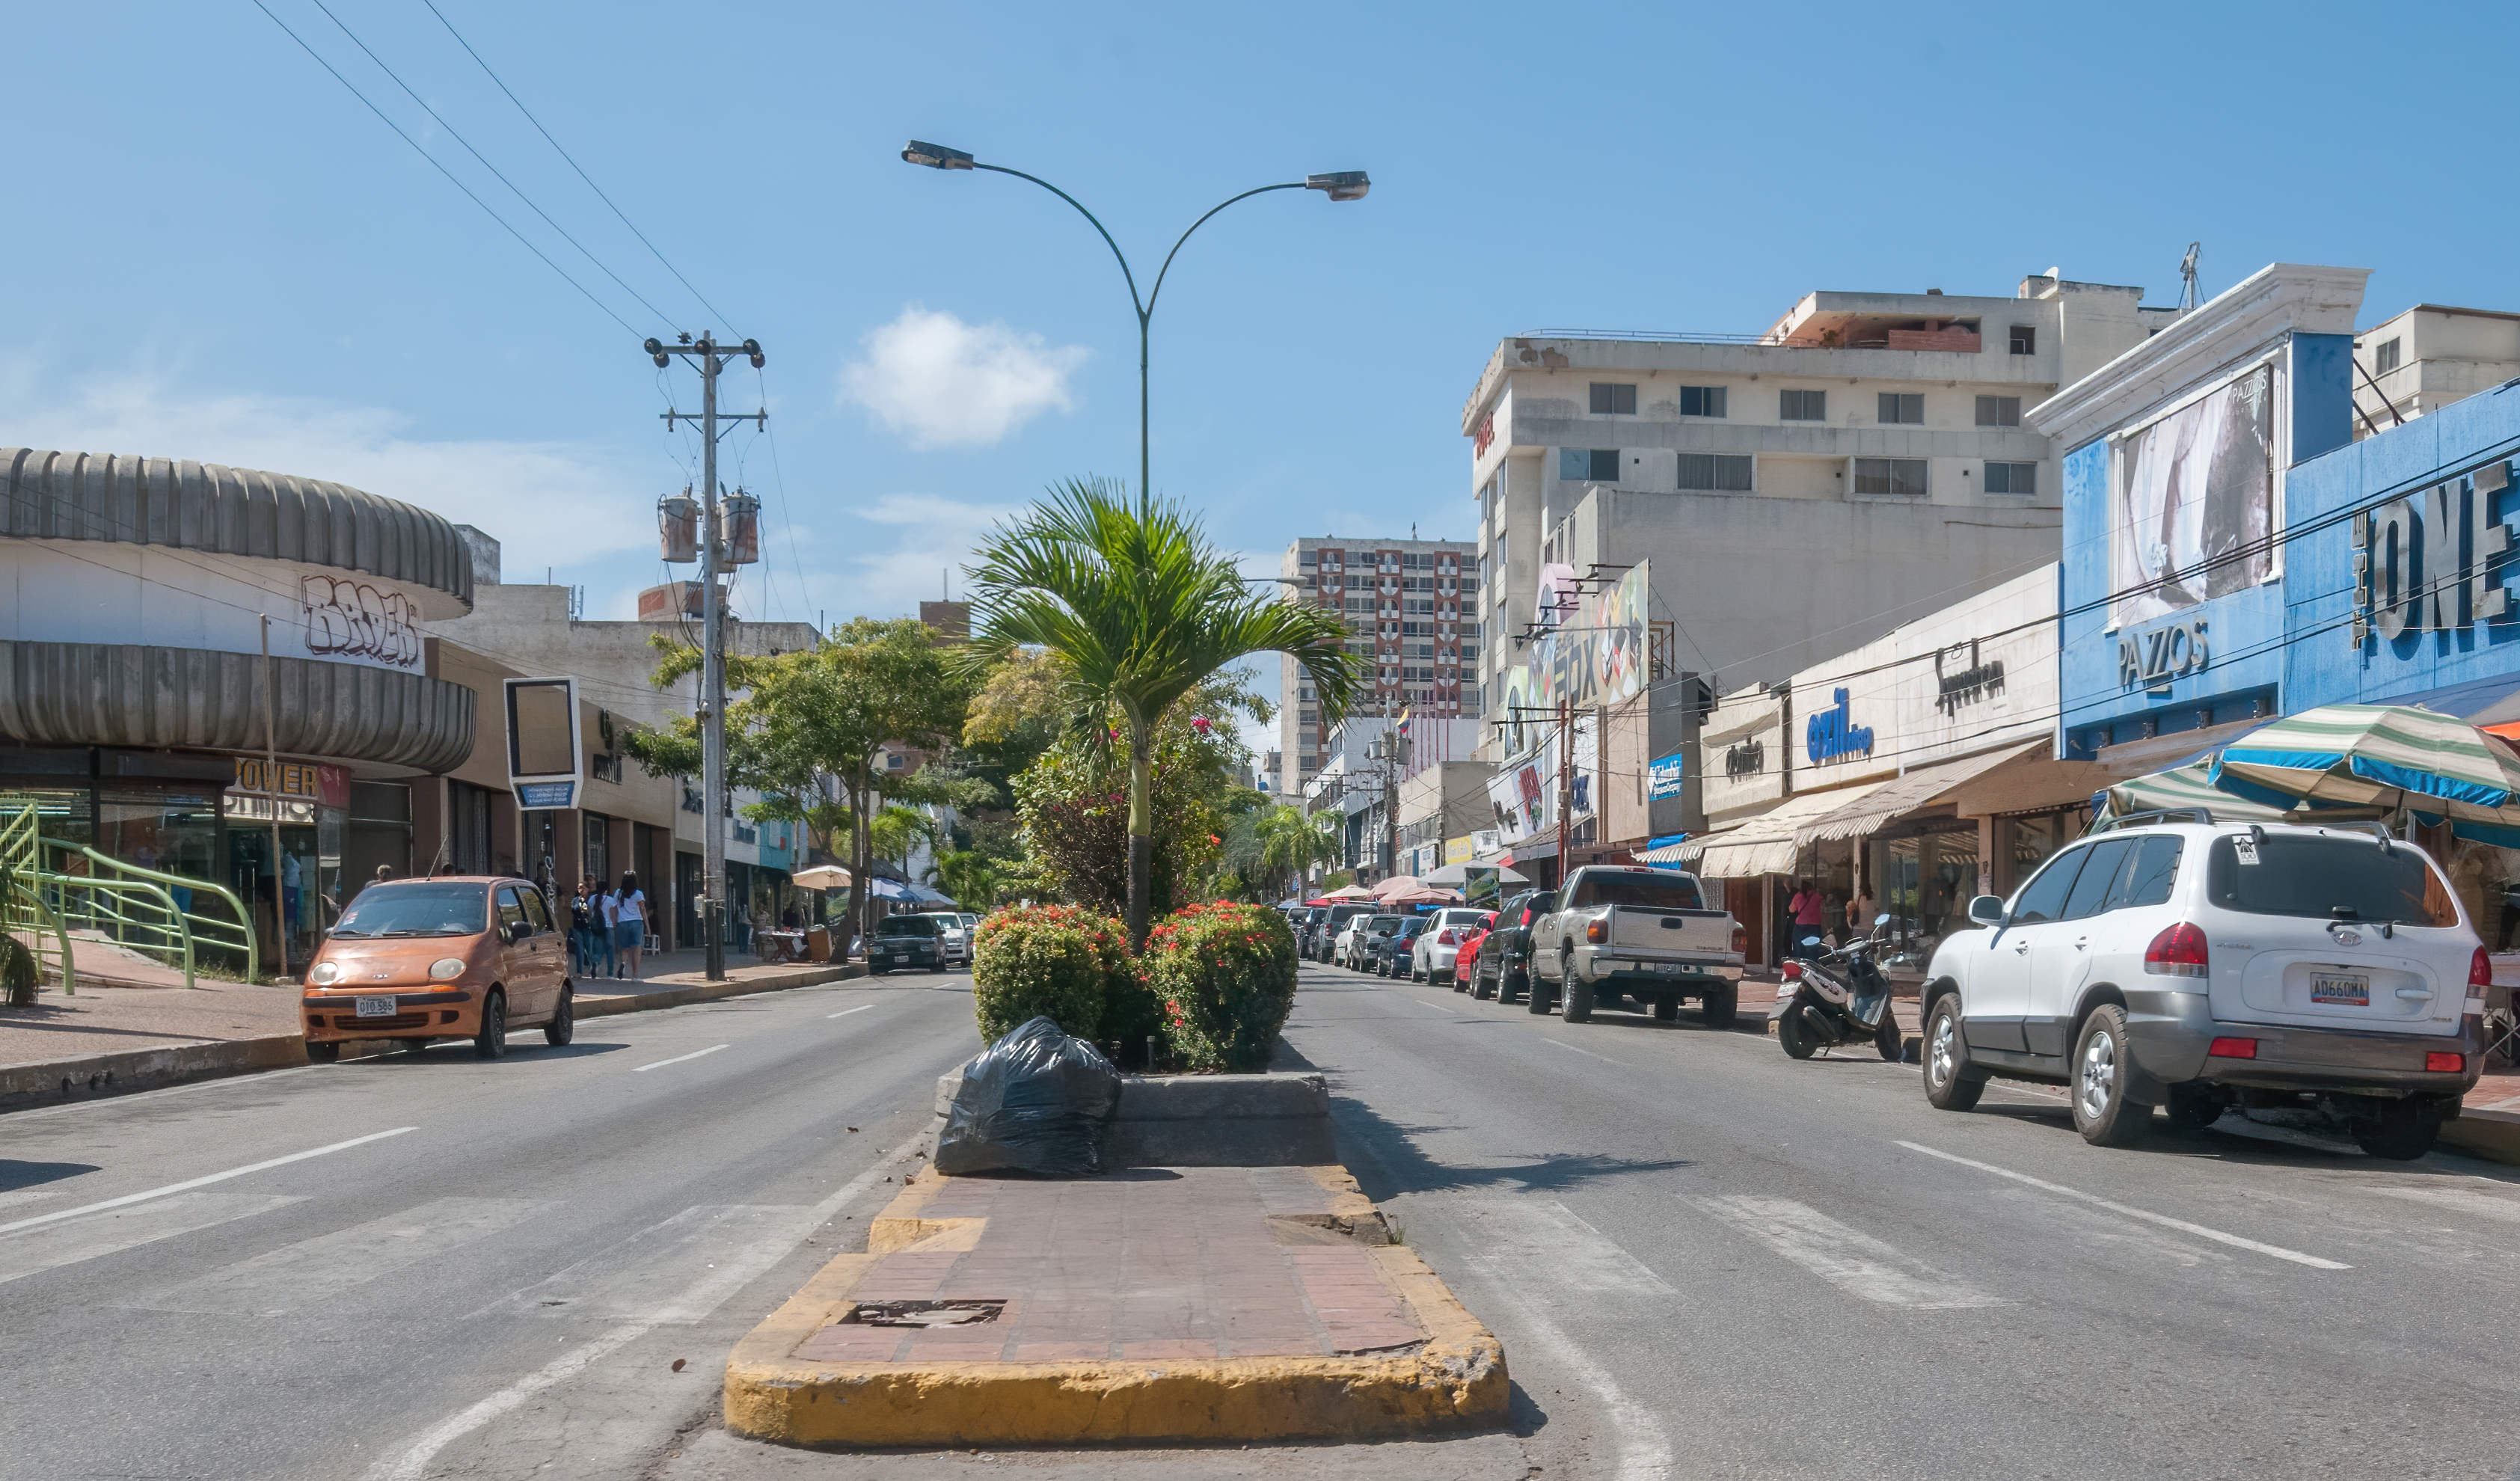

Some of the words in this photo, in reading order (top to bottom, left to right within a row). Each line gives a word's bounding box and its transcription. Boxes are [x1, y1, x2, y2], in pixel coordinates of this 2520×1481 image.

[2232, 372, 2266, 404] PAZZOS
[2374, 460, 2511, 642] ONE
[2118, 616, 2210, 693] PAZZOS
